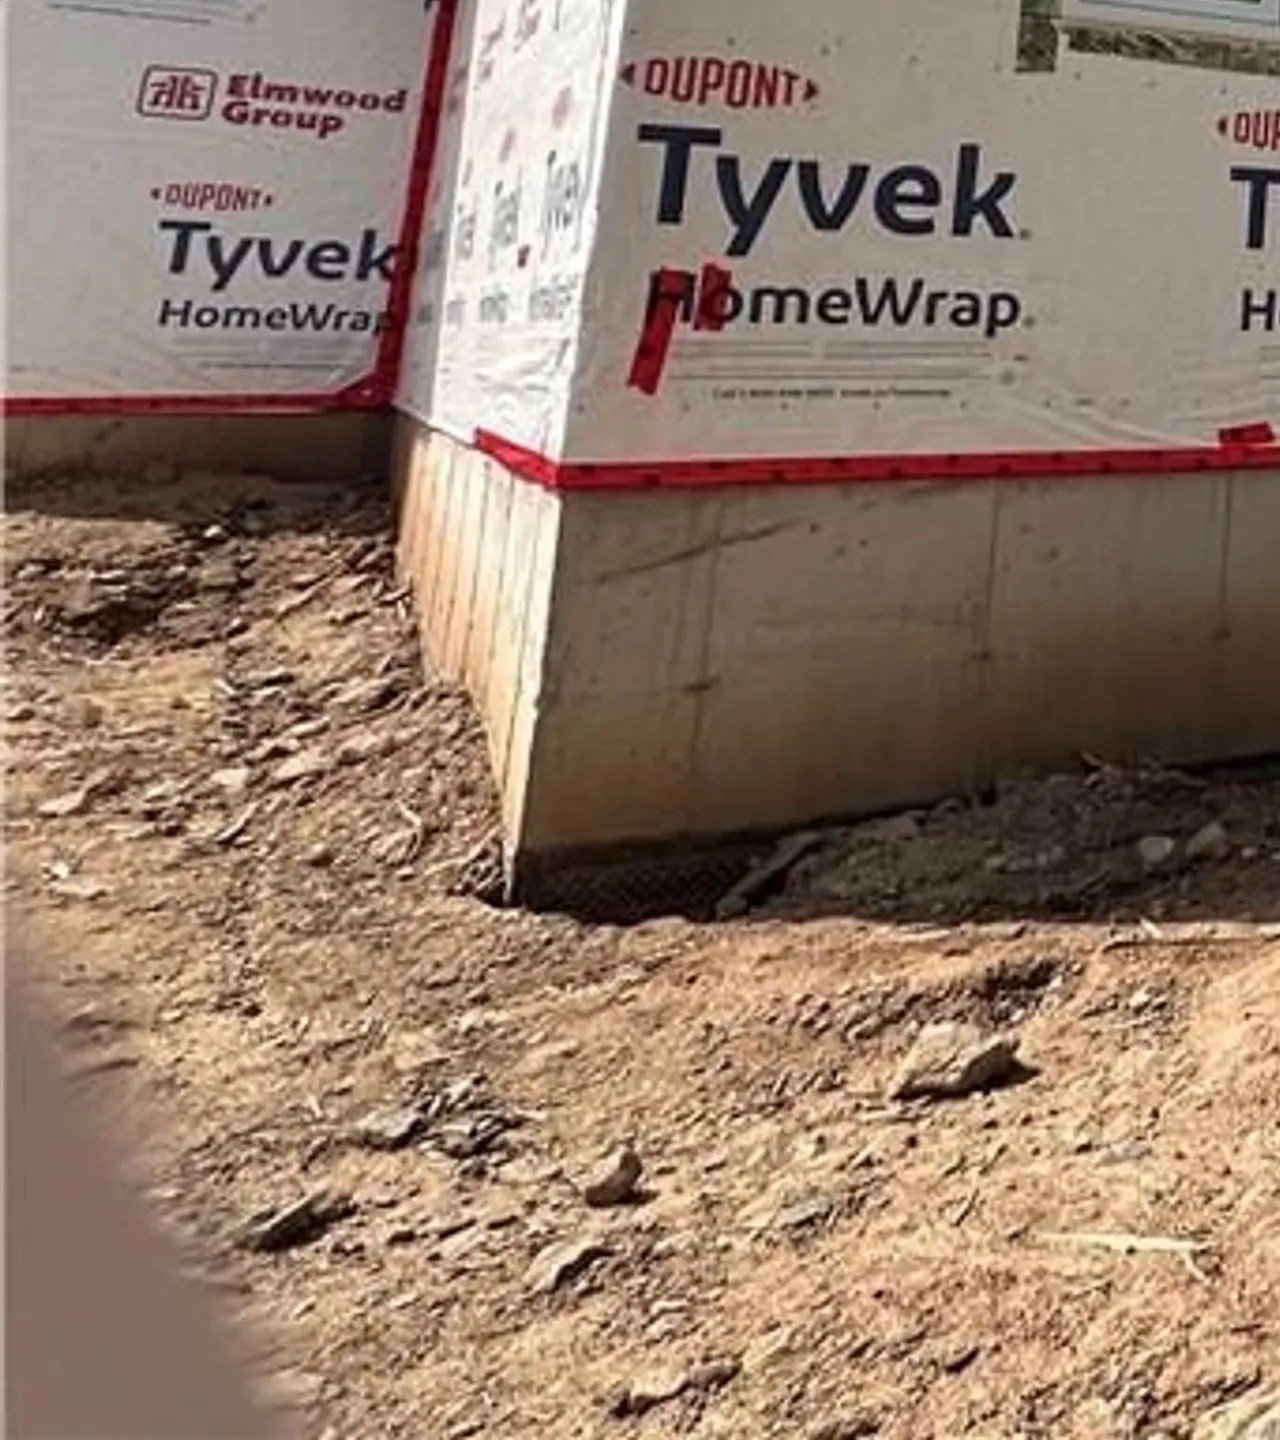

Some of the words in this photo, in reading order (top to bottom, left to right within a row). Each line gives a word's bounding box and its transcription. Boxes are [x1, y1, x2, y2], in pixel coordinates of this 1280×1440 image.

[226, 74, 407, 113] Elmwood
[643, 57, 800, 109] DUPONT
[221, 101, 345, 139] Group
[164, 183, 262, 212] DUPONT
[636, 123, 1017, 257] Tyvek
[159, 220, 406, 292] Tyvek
